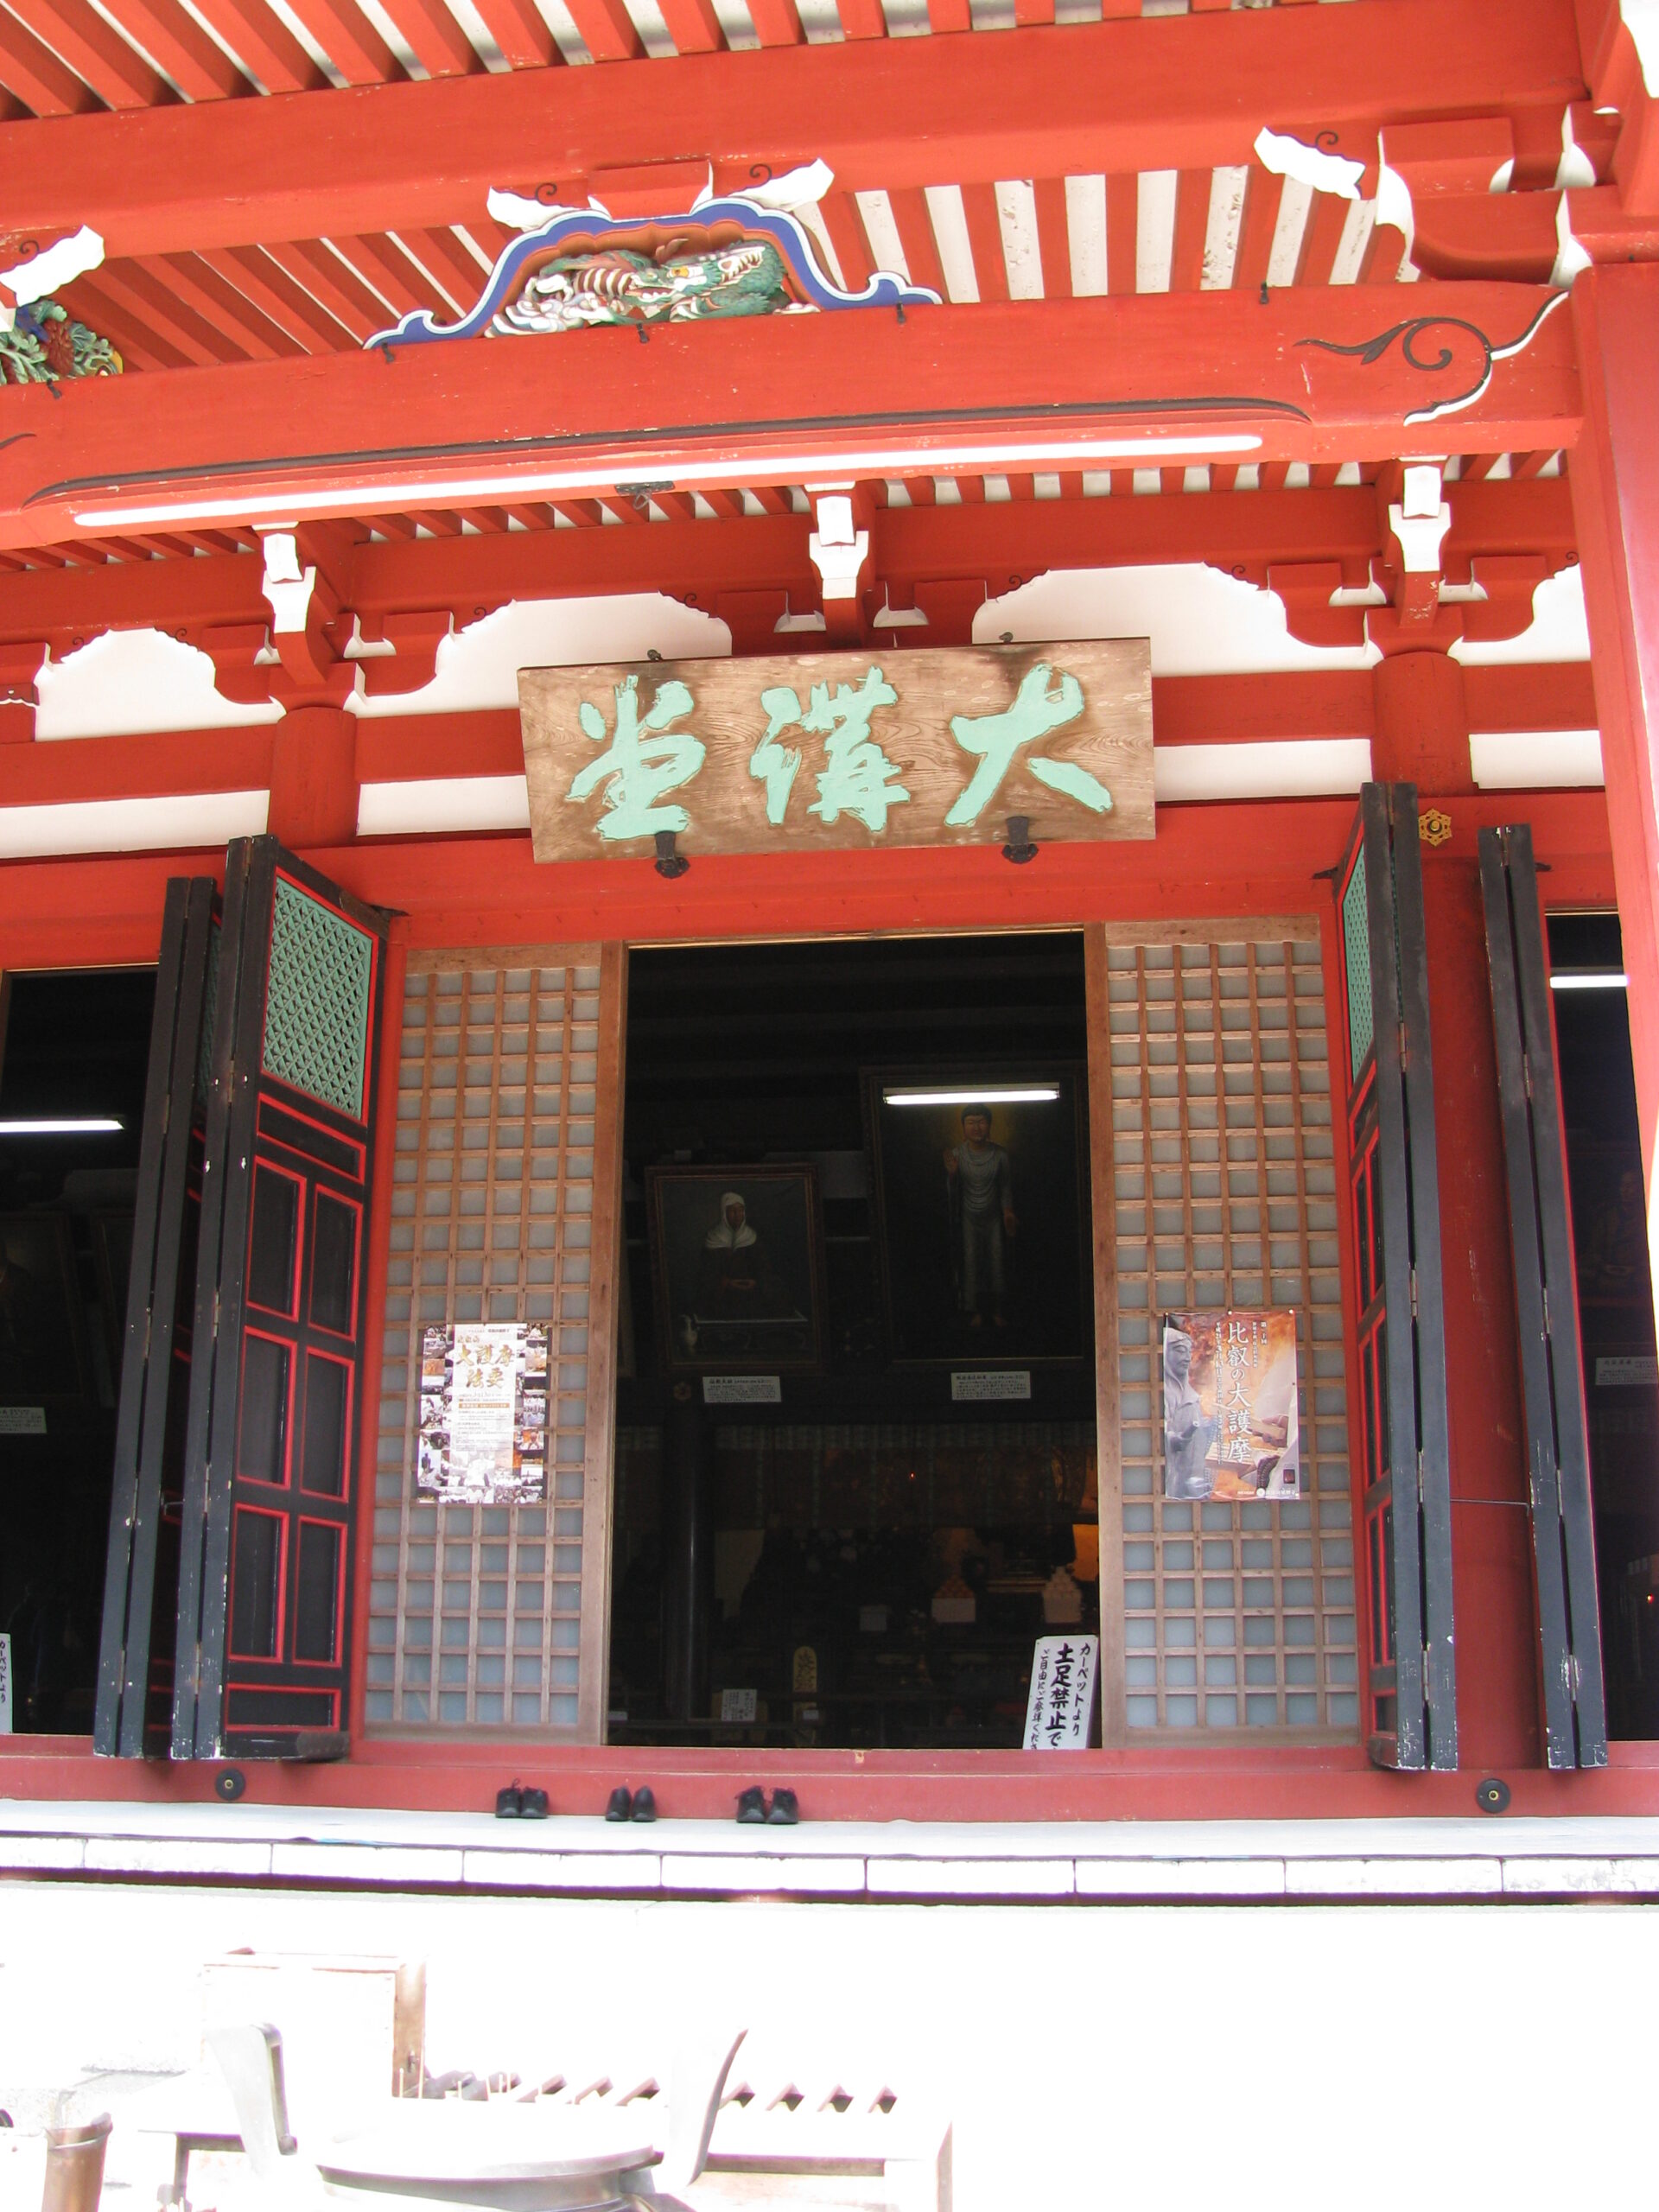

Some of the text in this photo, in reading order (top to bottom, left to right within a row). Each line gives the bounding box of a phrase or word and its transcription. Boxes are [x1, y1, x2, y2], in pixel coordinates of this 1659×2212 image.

[466, 1368, 504, 1389] 法要
[1227, 1320, 1252, 1463] 比叡の大護摩
[1045, 1642, 1075, 1750] 土足禁止で
[1072, 1642, 1090, 1737] カーペットより
